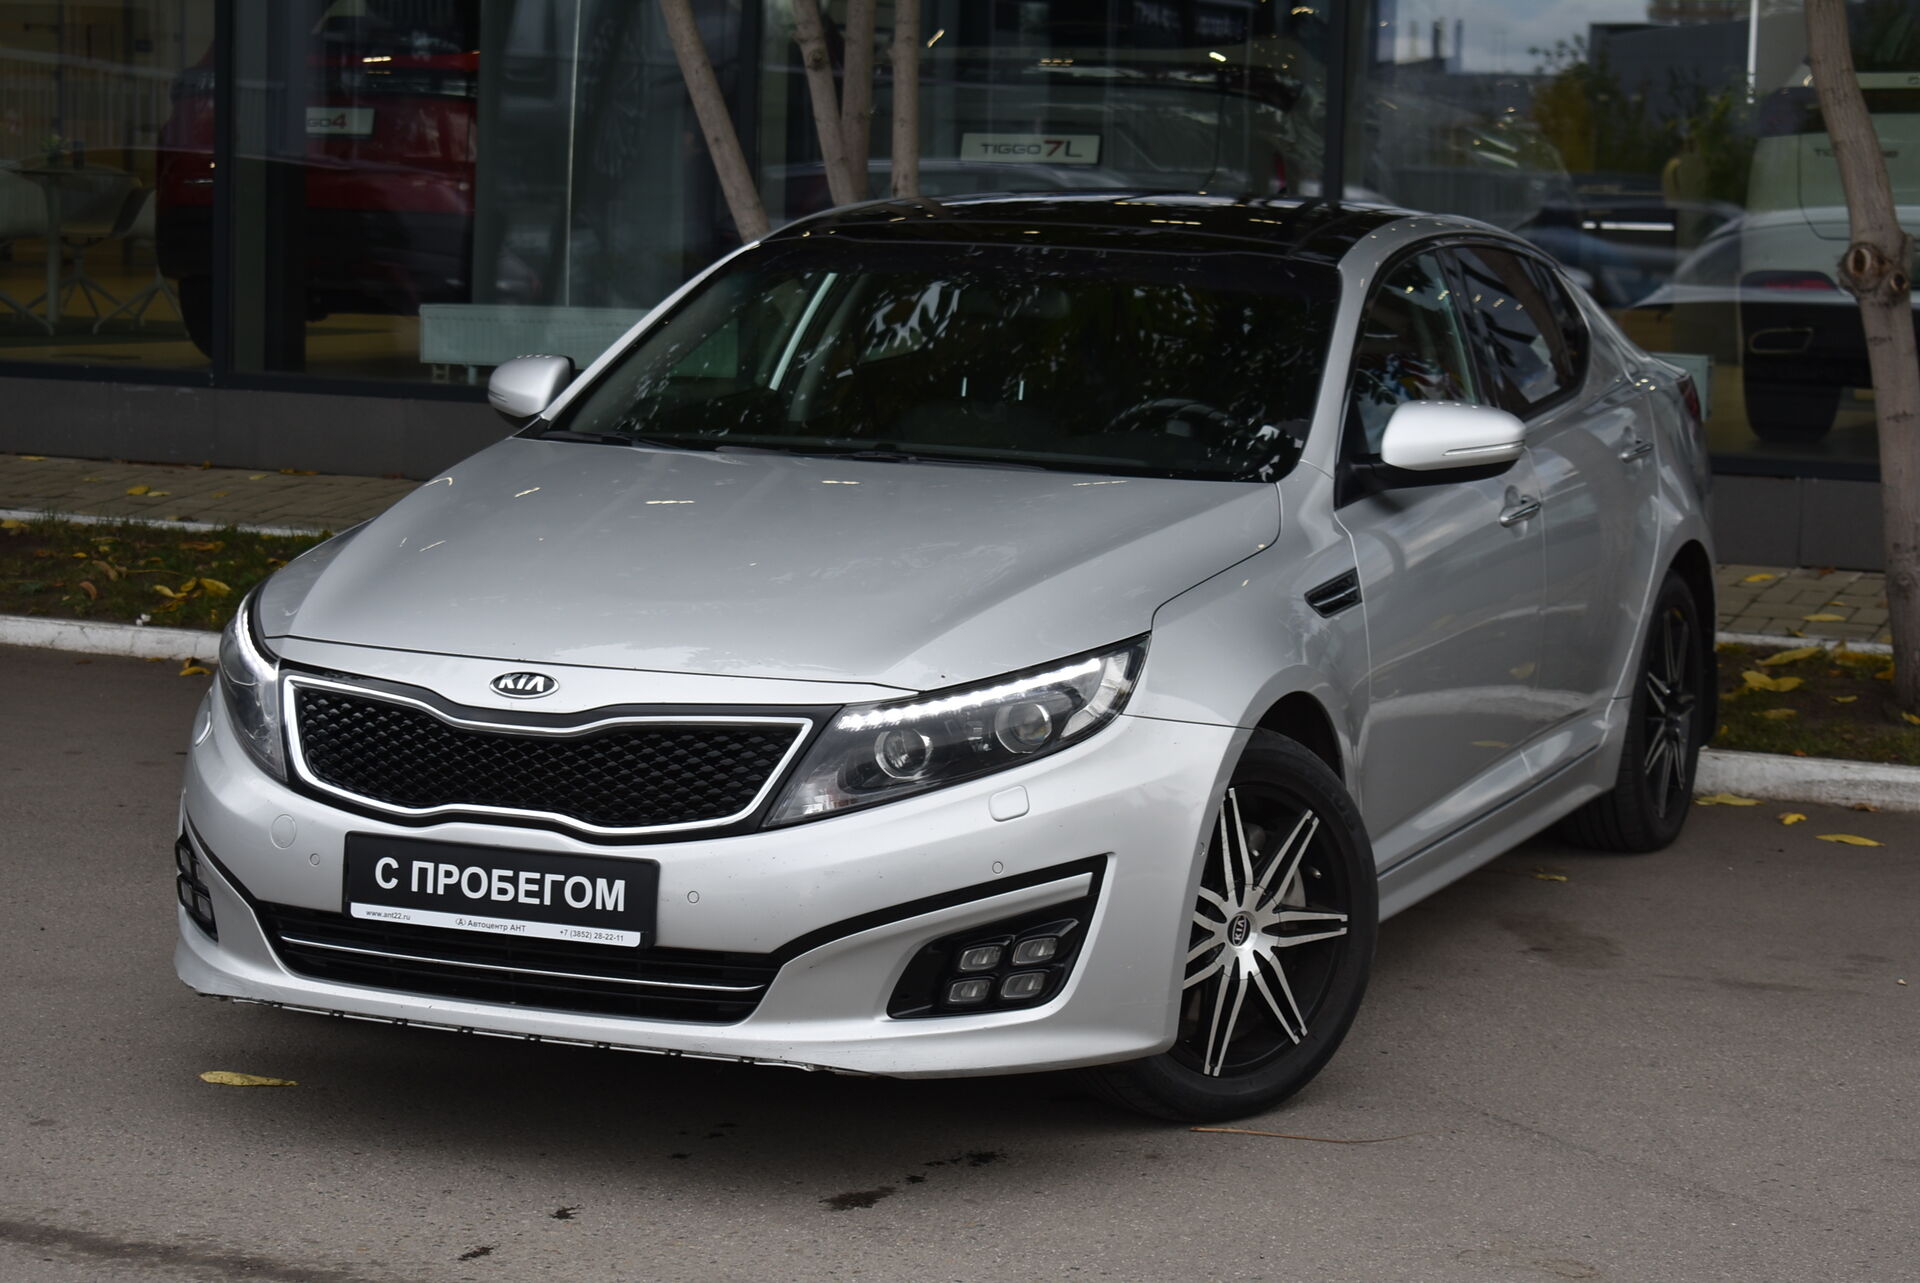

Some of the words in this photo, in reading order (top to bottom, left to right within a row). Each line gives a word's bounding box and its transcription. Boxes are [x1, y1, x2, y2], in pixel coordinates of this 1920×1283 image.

[498, 674, 545, 692] KIA
[374, 857, 399, 890] С
[411, 860, 626, 912] ПРОБЕГОМ
[365, 909, 411, 921] www.ant22.ru
[467, 919, 508, 932] Автоцентр
[510, 924, 527, 933] АНТ
[1234, 919, 1245, 941] KIA
[559, 929, 568, 937] +7
[569, 929, 592, 941] (3852)
[594, 932, 624, 942] 28-22-11
